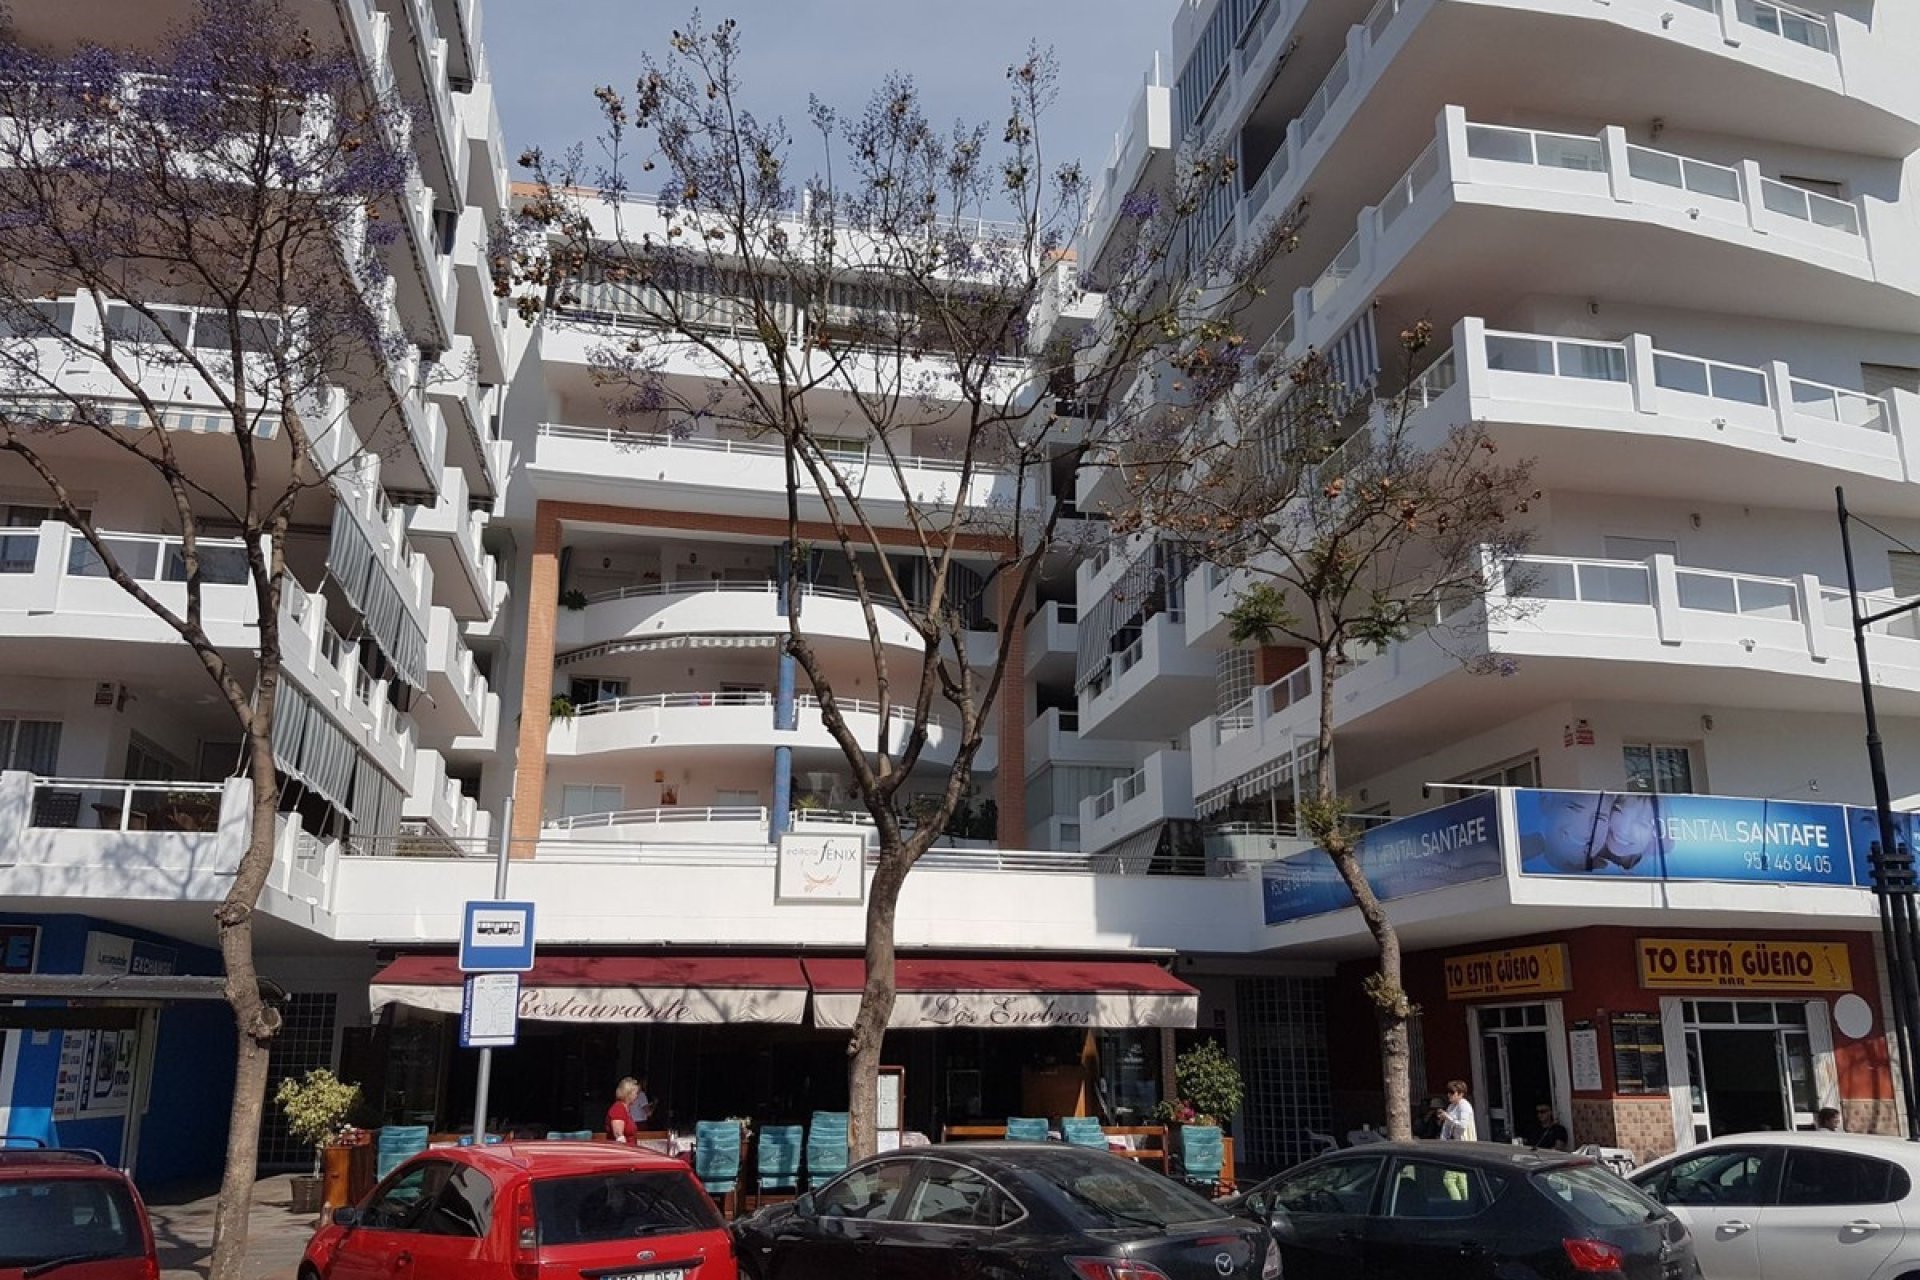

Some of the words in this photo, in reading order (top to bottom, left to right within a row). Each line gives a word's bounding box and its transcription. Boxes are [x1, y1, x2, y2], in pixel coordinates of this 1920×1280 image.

[1774, 853, 1792, 871] 46
[1795, 854, 1811, 872] 84
[1814, 855, 1832, 874] 05
[0, 935, 32, 968] E
[1645, 947, 1677, 973] TO
[1685, 943, 1734, 975] ESTÁ
[1742, 943, 1814, 976] GÜENO
[1447, 965, 1463, 987] TO
[1497, 952, 1539, 982] GÜENO
[1719, 977, 1745, 986] BAR
[519, 989, 691, 1019] Restaurante
[920, 996, 977, 1024] Los
[990, 996, 1089, 1024] Enebros
